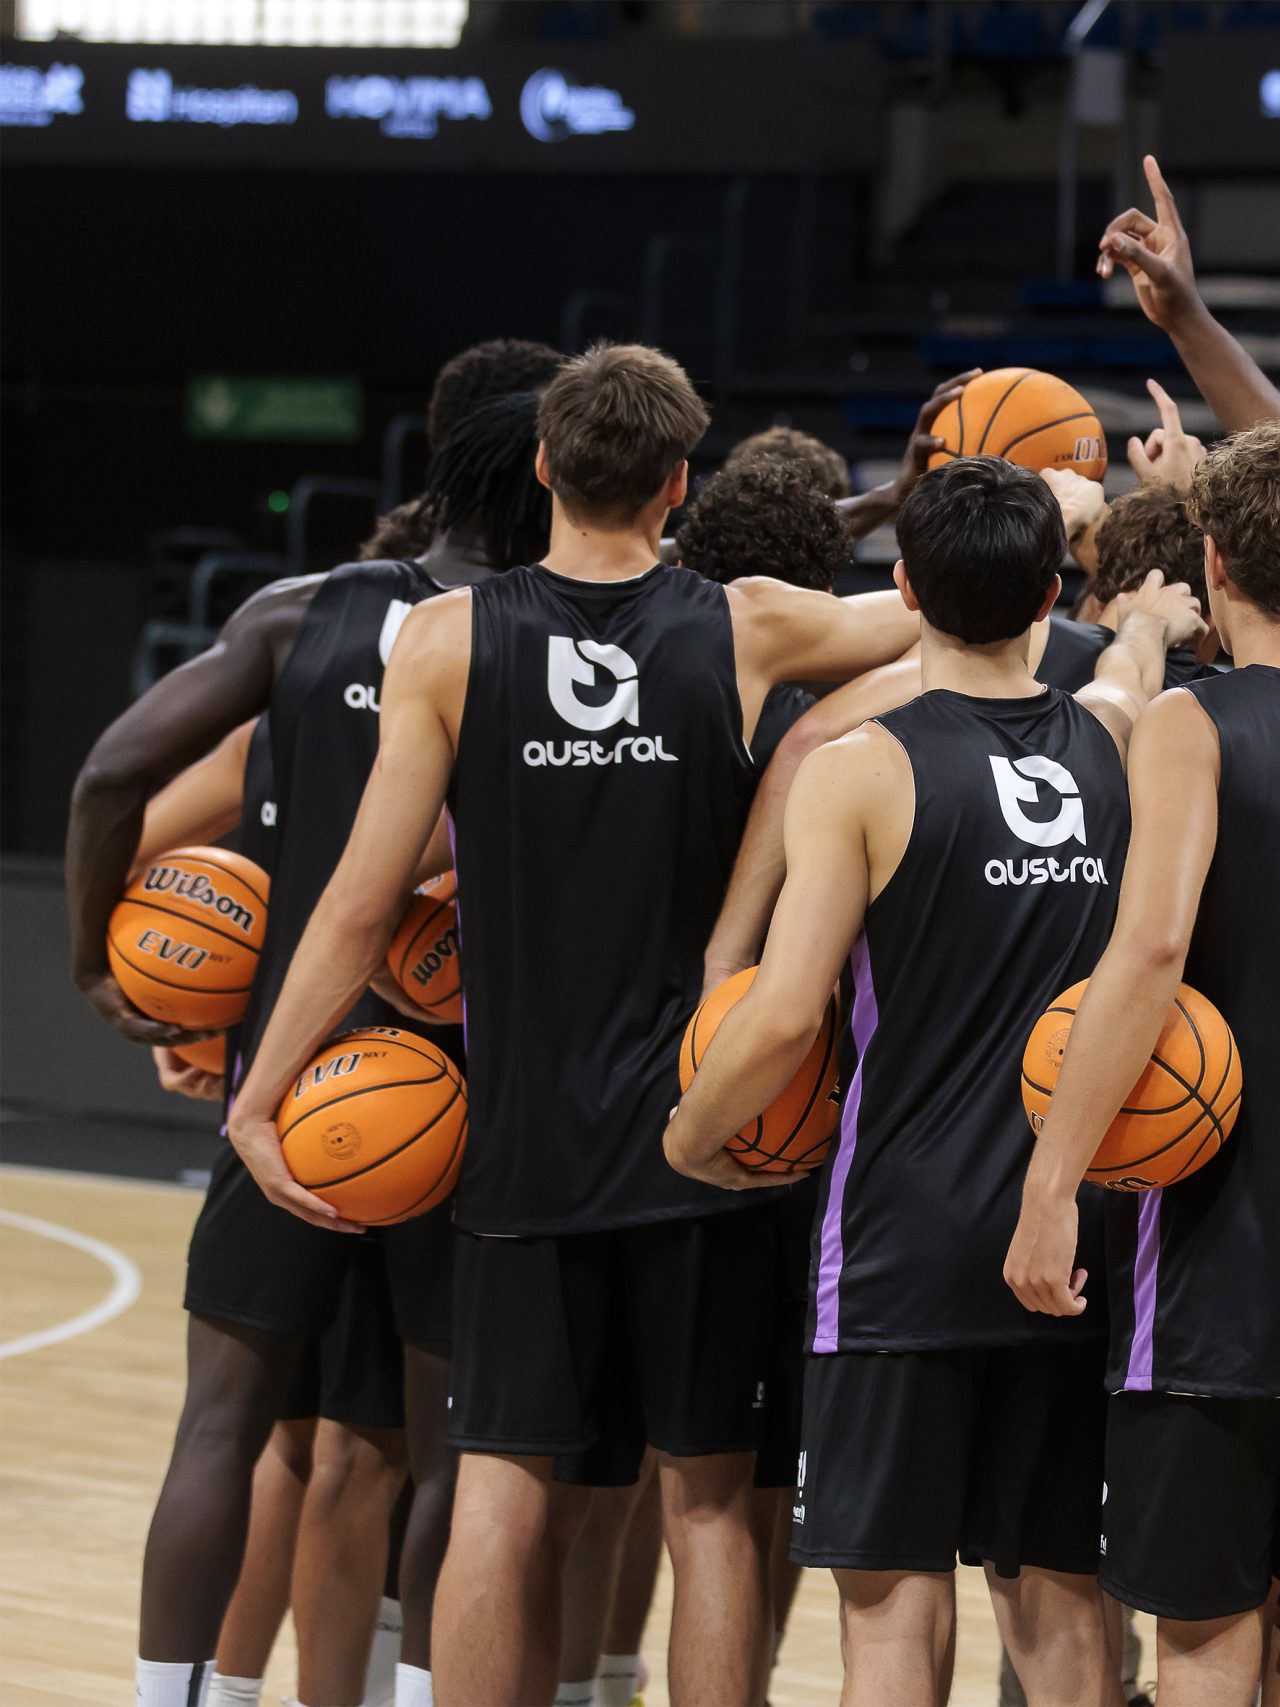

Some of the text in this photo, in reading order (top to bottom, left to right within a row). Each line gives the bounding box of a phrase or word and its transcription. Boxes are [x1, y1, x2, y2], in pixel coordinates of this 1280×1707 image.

[523, 735, 679, 767] austral
[984, 856, 1109, 886] austral
[144, 866, 255, 935] Wilson
[137, 928, 211, 970] EVO
